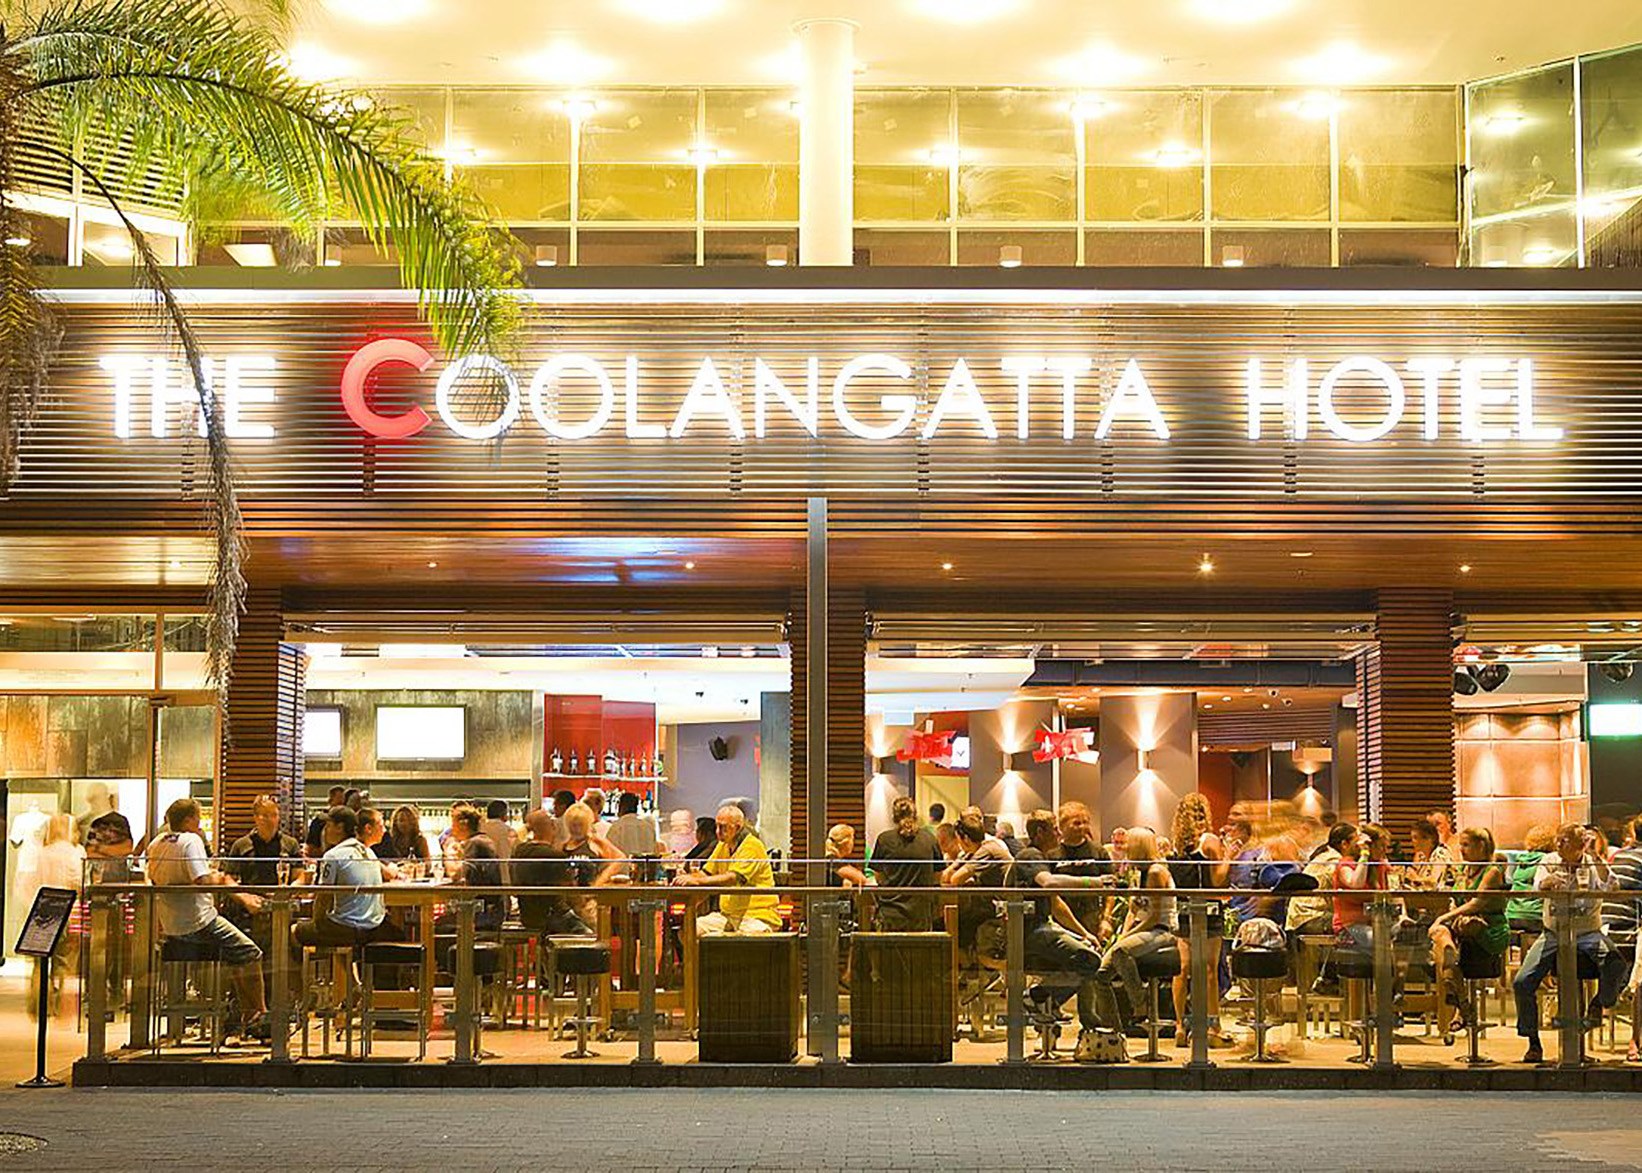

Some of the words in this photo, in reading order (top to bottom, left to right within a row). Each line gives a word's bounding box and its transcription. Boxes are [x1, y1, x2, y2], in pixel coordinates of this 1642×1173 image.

[99, 356, 275, 438] THE
[341, 338, 1170, 440] COOLANGATTA
[1247, 356, 1564, 441] HOTEL
